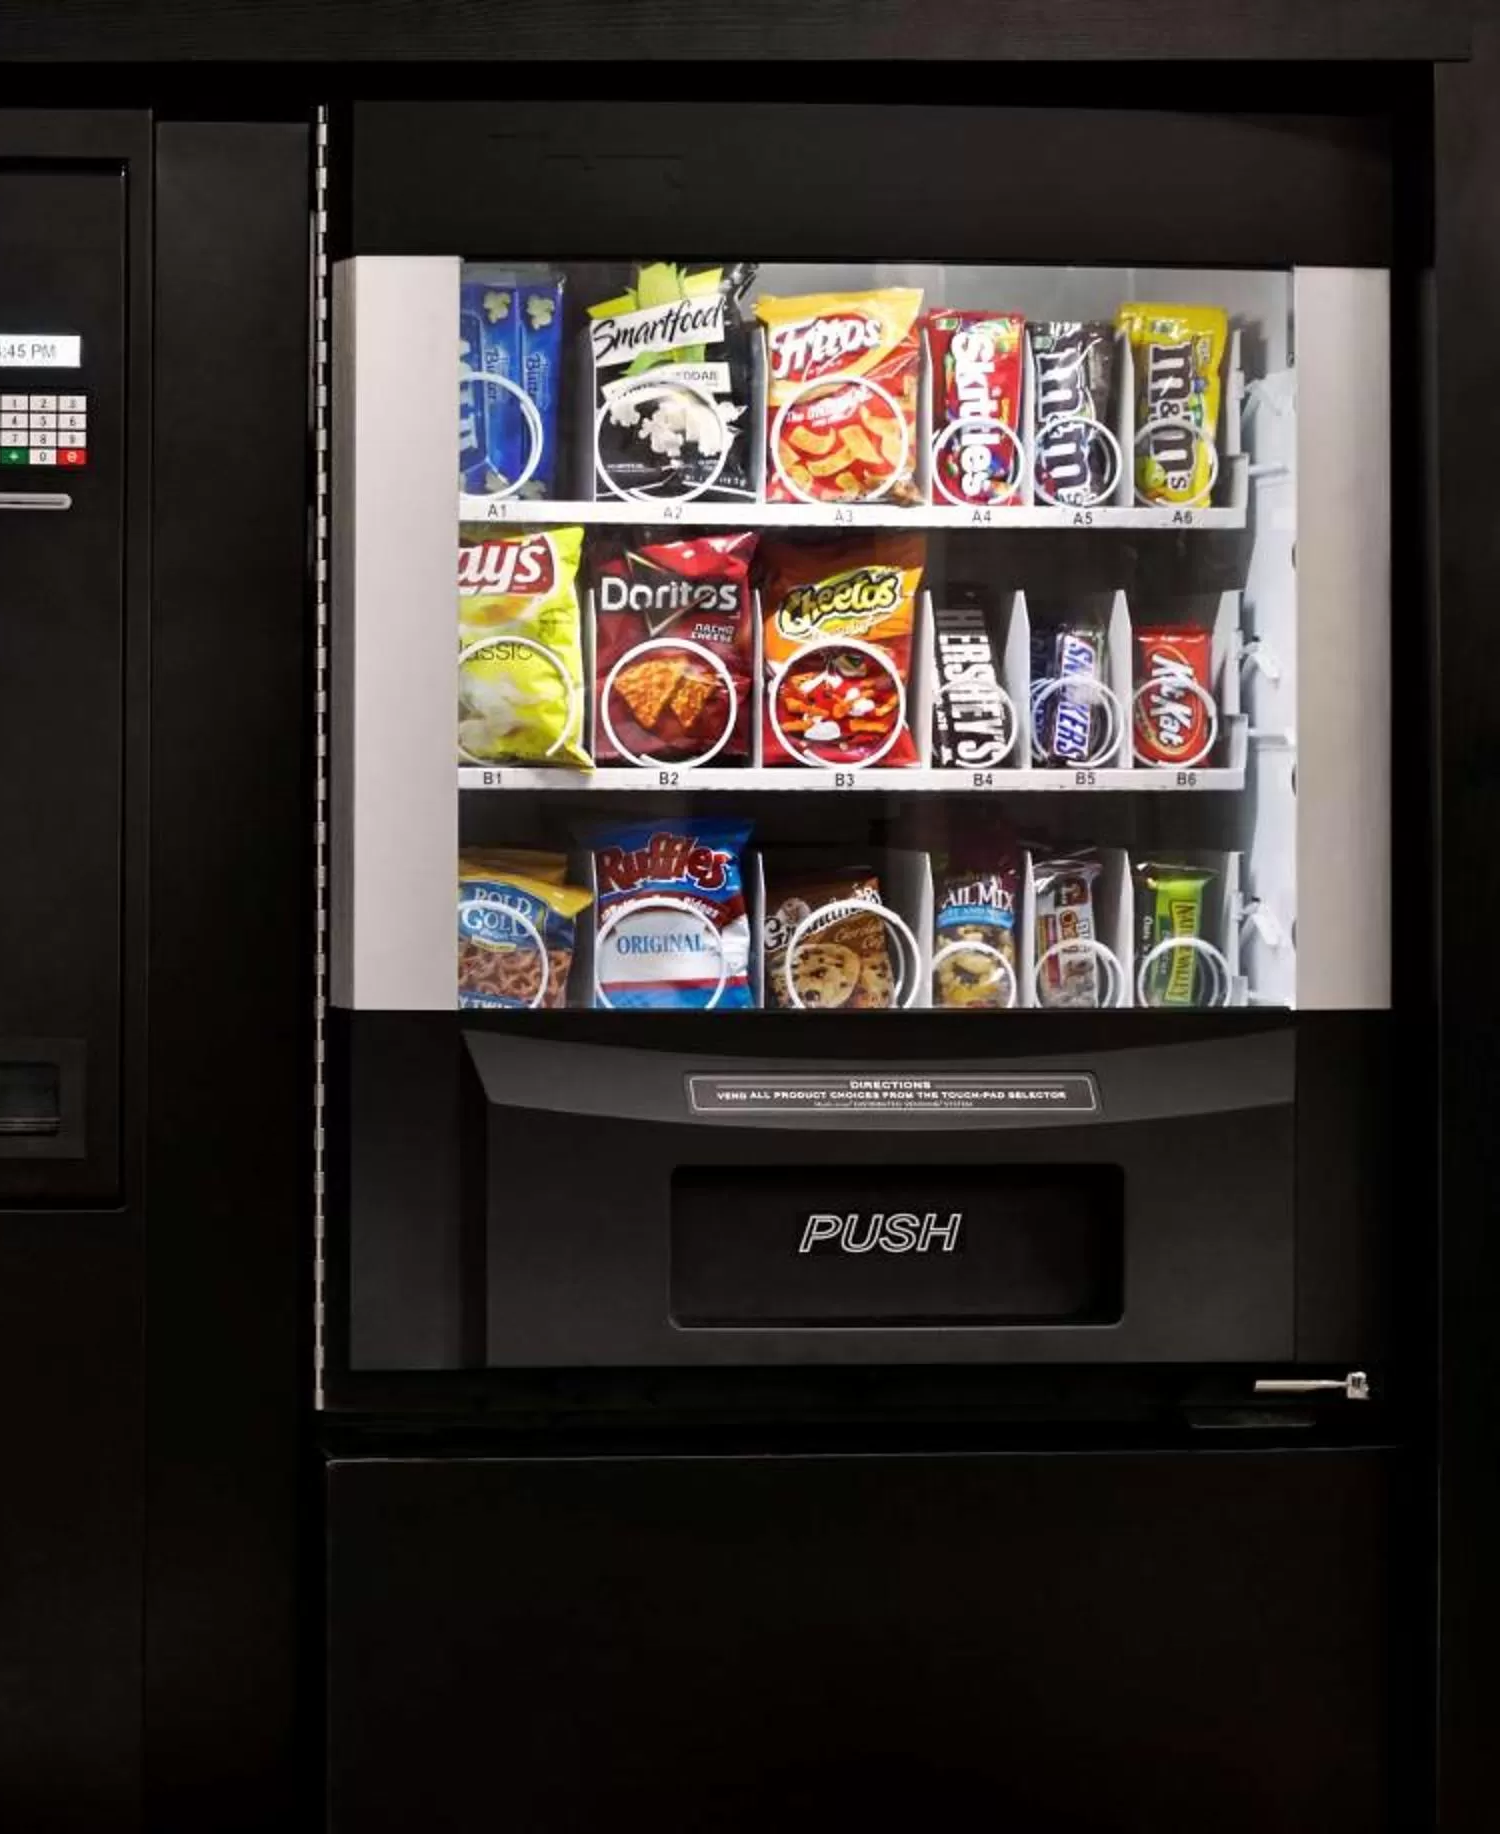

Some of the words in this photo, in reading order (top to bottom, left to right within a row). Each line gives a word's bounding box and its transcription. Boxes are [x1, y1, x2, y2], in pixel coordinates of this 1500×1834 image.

[593, 298, 726, 361] Smartfood
[31, 344, 57, 359] PM
[771, 318, 883, 379] Fritos
[483, 346, 498, 400] Buter
[951, 322, 1003, 497] Skittles
[69, 417, 76, 426] 6
[40, 434, 47, 444] 8
[487, 504, 507, 518] A1
[663, 505, 683, 519] A2
[835, 509, 854, 522] A3
[972, 510, 992, 522] A4
[1073, 513, 1093, 525] A5
[1172, 512, 1193, 525] A6
[458, 533, 547, 593] ay's
[601, 576, 738, 611] Doritos
[781, 571, 898, 636] Cheetos
[1057, 643, 1094, 760] SNKERS
[483, 772, 502, 785] B1
[659, 772, 679, 785] B2
[835, 773, 855, 786] B3
[973, 774, 993, 786] B4
[1076, 773, 1095, 785] B5
[1177, 773, 1197, 785] B6
[597, 832, 733, 893] Ruffles
[941, 884, 978, 909] AIL
[462, 906, 534, 938] GOLD
[617, 933, 705, 954] ORIGINAL
[850, 1081, 932, 1089] DIRECTIONS
[716, 1091, 747, 1100] VEND
[750, 1091, 771, 1099] ALL
[773, 1091, 827, 1099] PRODUCT
[830, 1091, 879, 1099] CHOICES
[882, 1091, 914, 1099] FROM
[917, 1091, 938, 1099] THE
[1008, 1091, 1066, 1099] SELECTOR
[799, 1213, 961, 1254] PUSH
